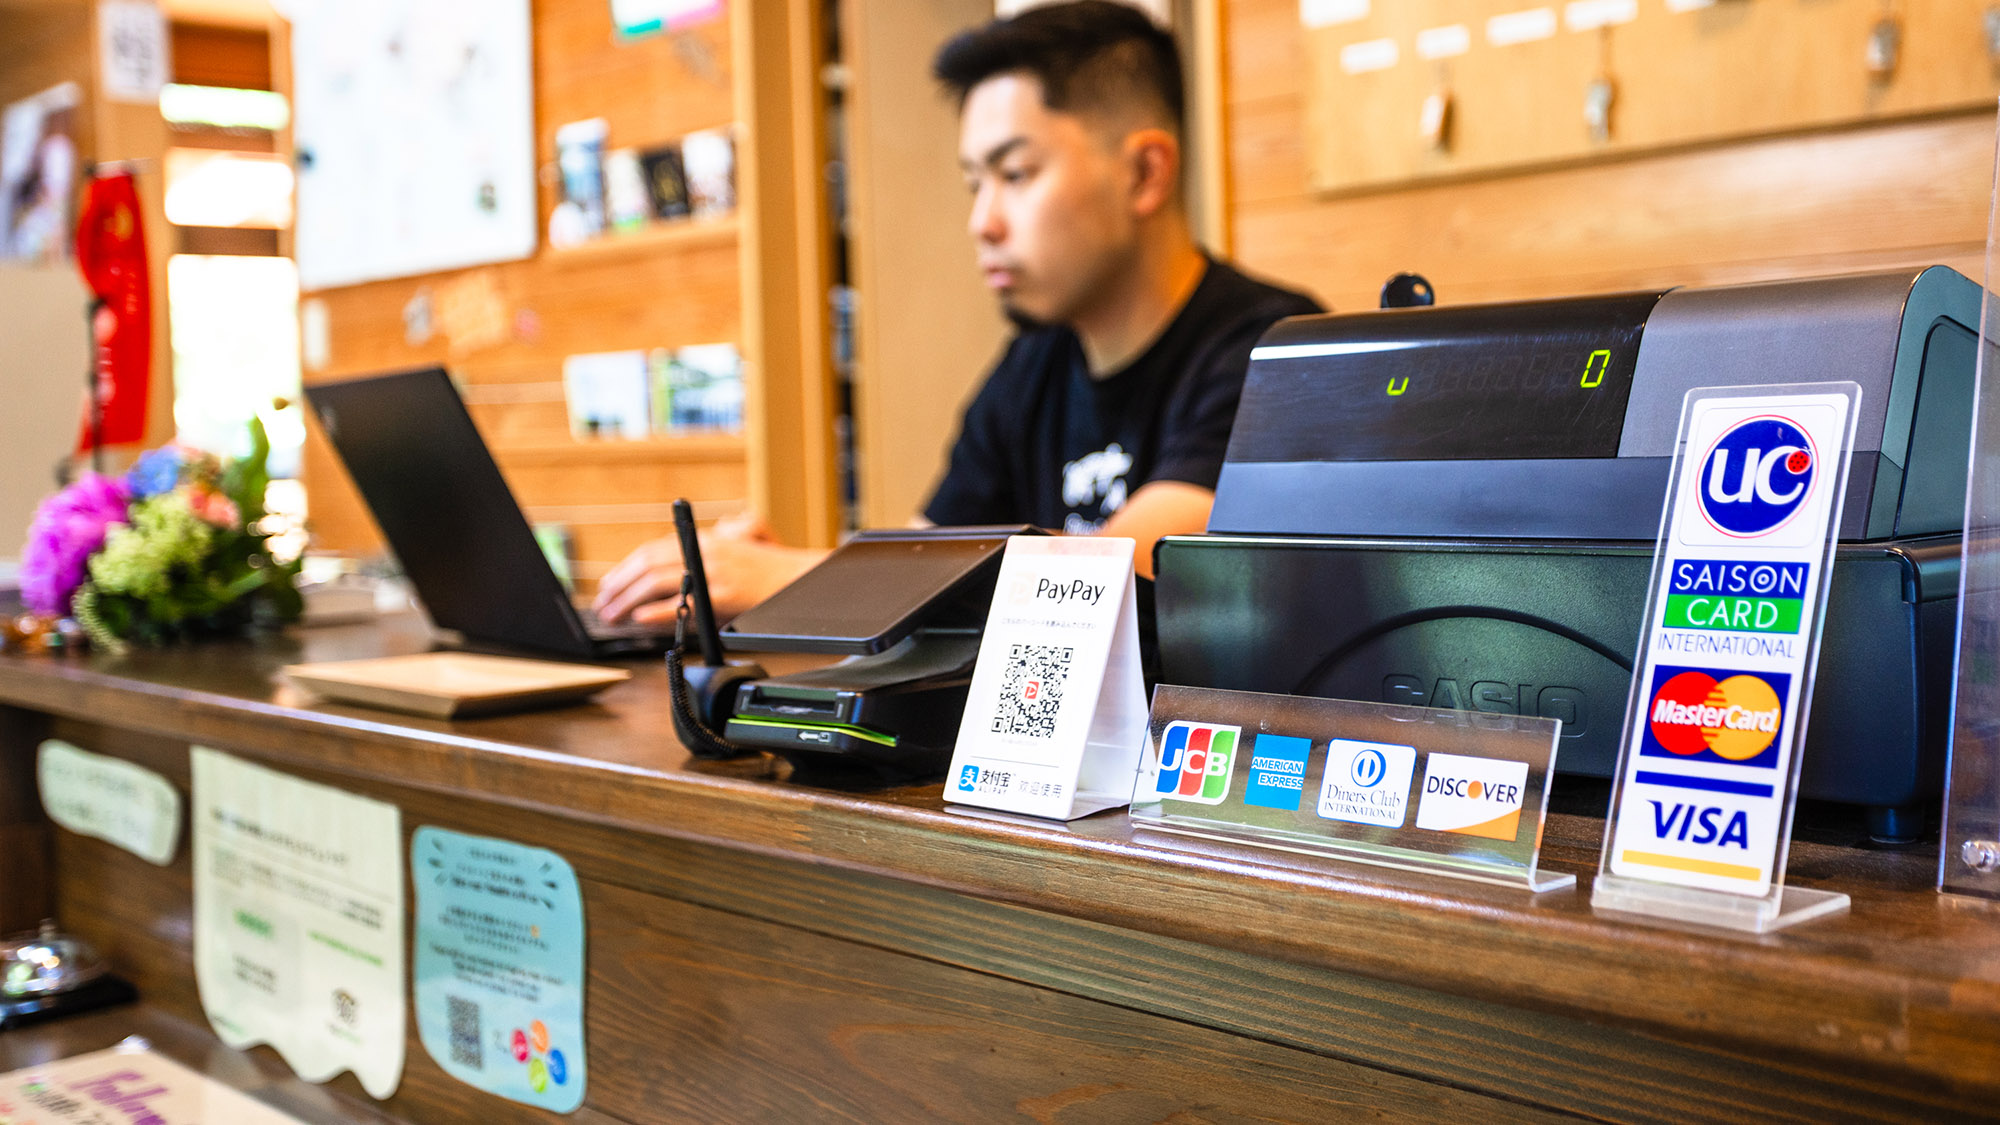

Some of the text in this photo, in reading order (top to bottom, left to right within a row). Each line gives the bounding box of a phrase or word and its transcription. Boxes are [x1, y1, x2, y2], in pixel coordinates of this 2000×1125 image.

[1581, 349, 1611, 388] 0
[1036, 578, 1106, 606] PayPay
[1674, 563, 1804, 594] SAISON
[1686, 598, 1779, 629] CARD
[1657, 632, 1796, 659] INTERNATIONAL
[1383, 673, 1588, 738] CASIO
[1652, 698, 1780, 733] MasterCard
[1160, 747, 1229, 777] JCB
[1251, 756, 1304, 774] AMERICAN
[979, 769, 1012, 788] 支付宝
[1258, 774, 1304, 790] EXPRESS
[1426, 775, 1519, 805] DISCOVER
[1326, 783, 1401, 808] Diners Club
[1324, 801, 1397, 821] INTERNATIONAL
[1647, 799, 1749, 850] VISA
